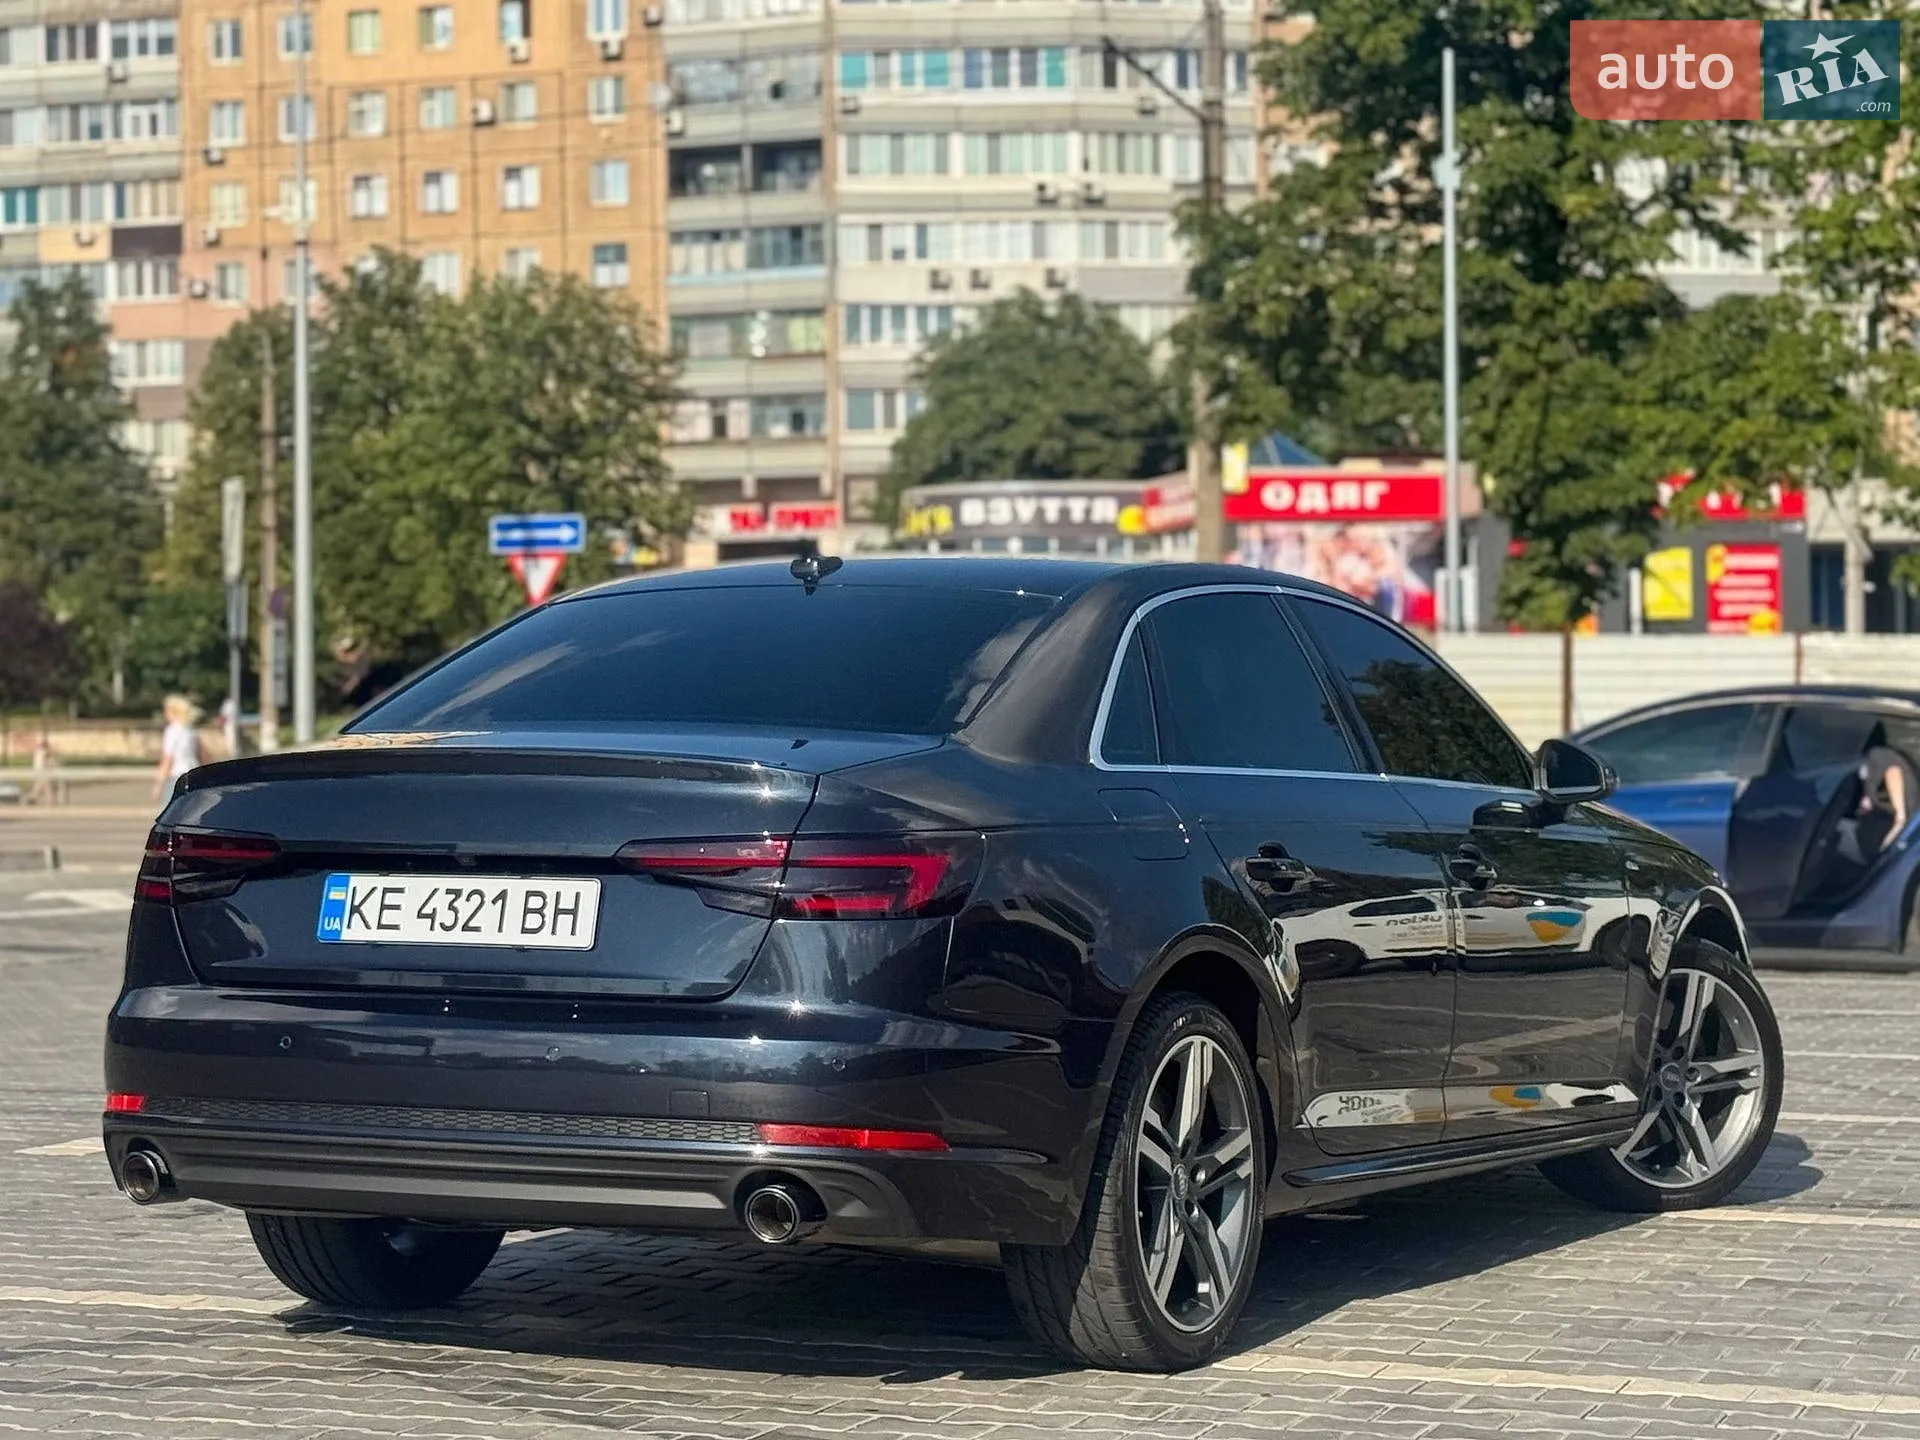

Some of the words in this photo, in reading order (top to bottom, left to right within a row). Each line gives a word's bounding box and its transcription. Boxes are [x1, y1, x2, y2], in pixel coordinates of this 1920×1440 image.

[959, 496, 1119, 526] ВЗУТТЯ
[1260, 479, 1390, 514] ОДЯГ
[324, 916, 341, 931] UA
[346, 886, 405, 931] KE
[416, 887, 509, 934] 4321
[520, 890, 582, 937] BH
